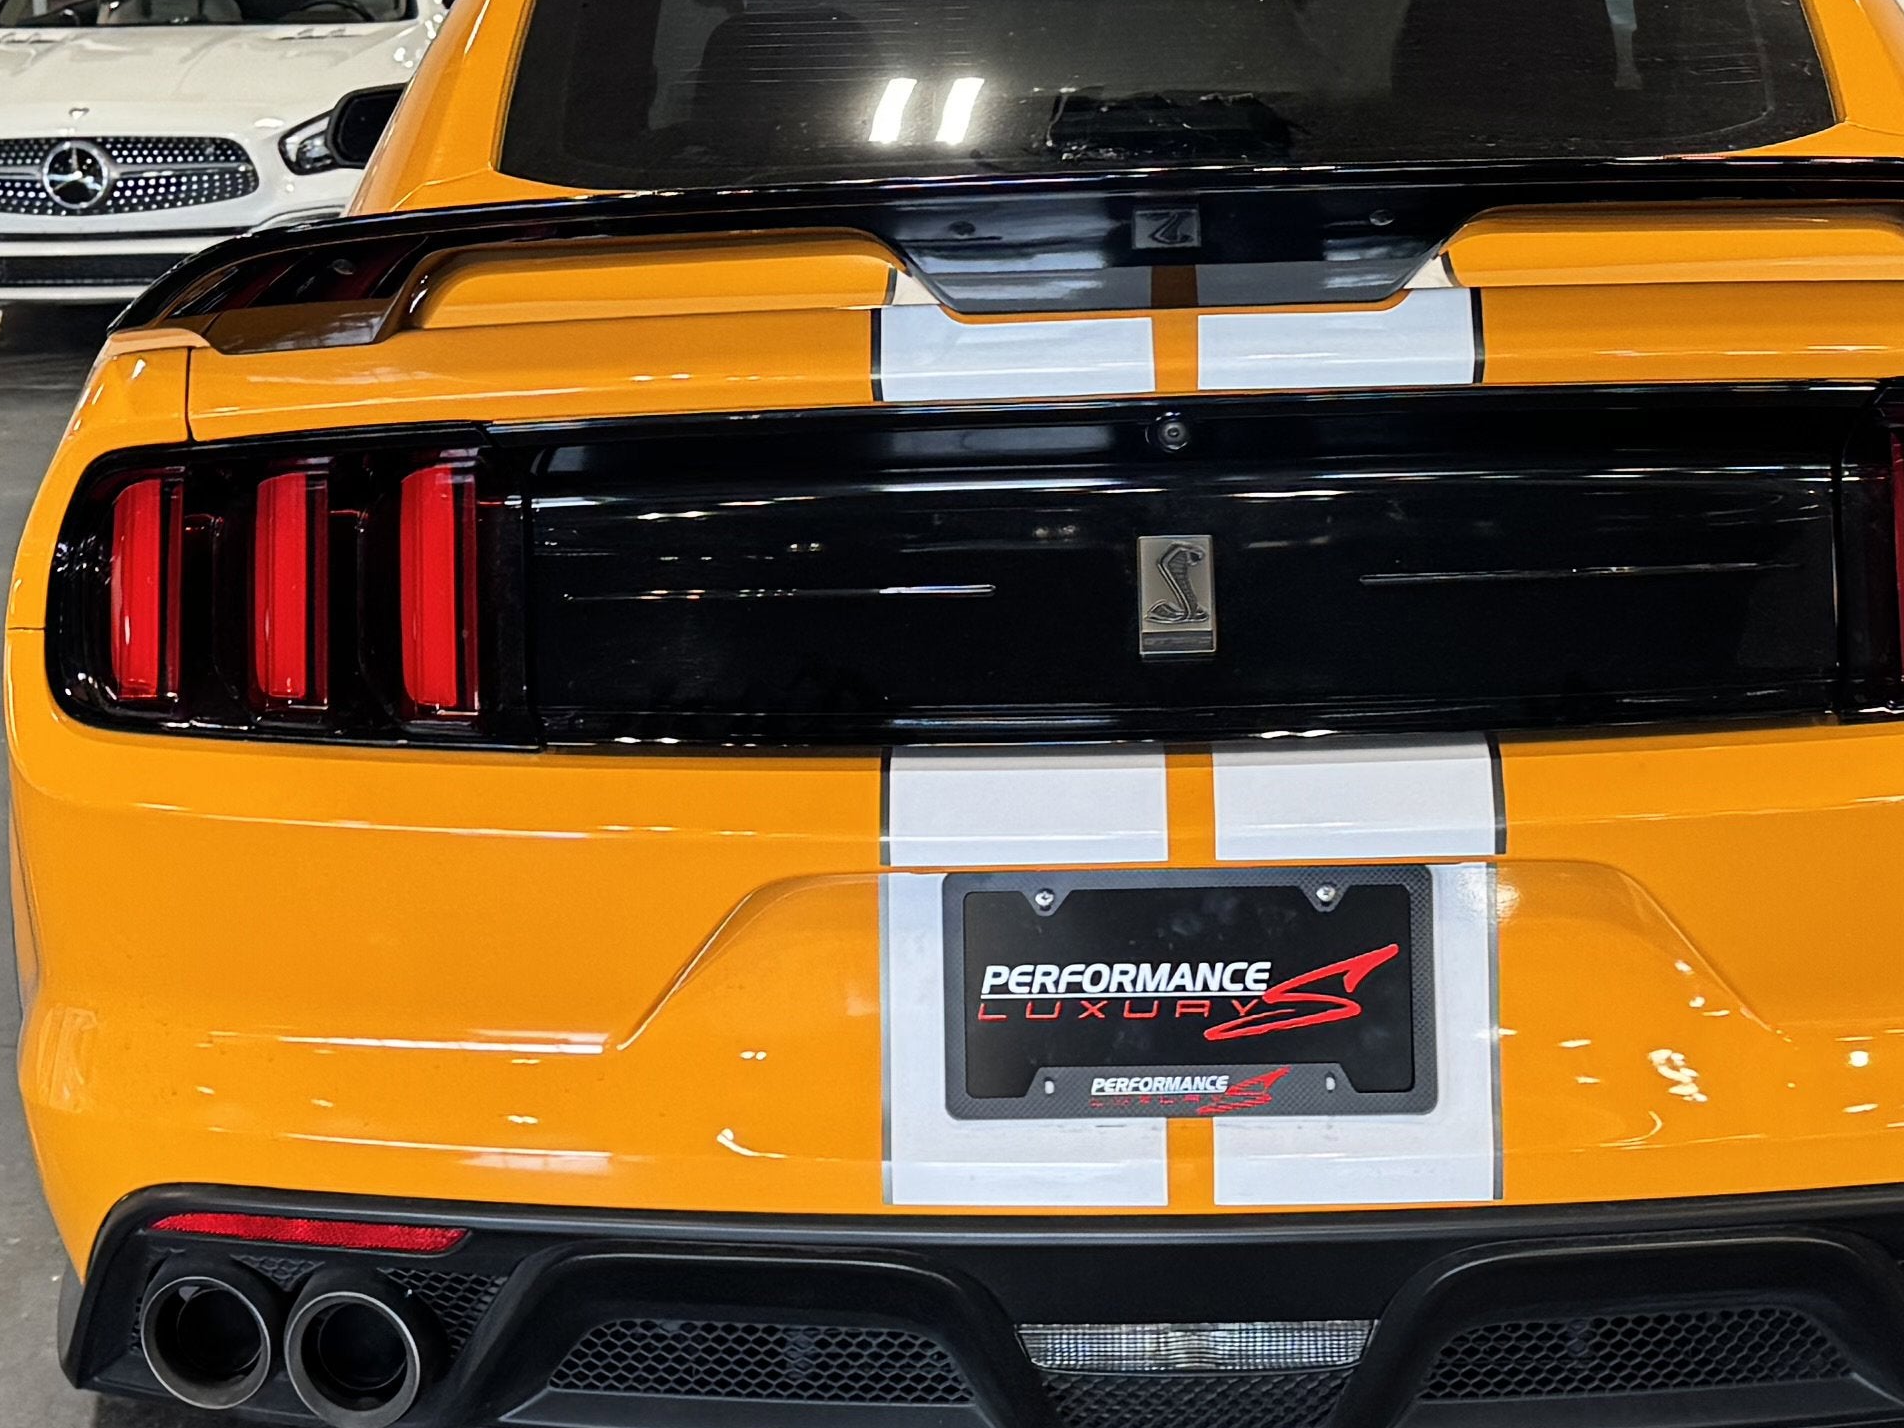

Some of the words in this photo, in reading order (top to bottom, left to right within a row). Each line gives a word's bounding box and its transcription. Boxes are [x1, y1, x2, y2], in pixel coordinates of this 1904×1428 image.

[981, 961, 1272, 994] PERFORMANCE
[977, 998, 1261, 1021] LUXURY
[1091, 1075, 1230, 1094] PERFORMANCE
